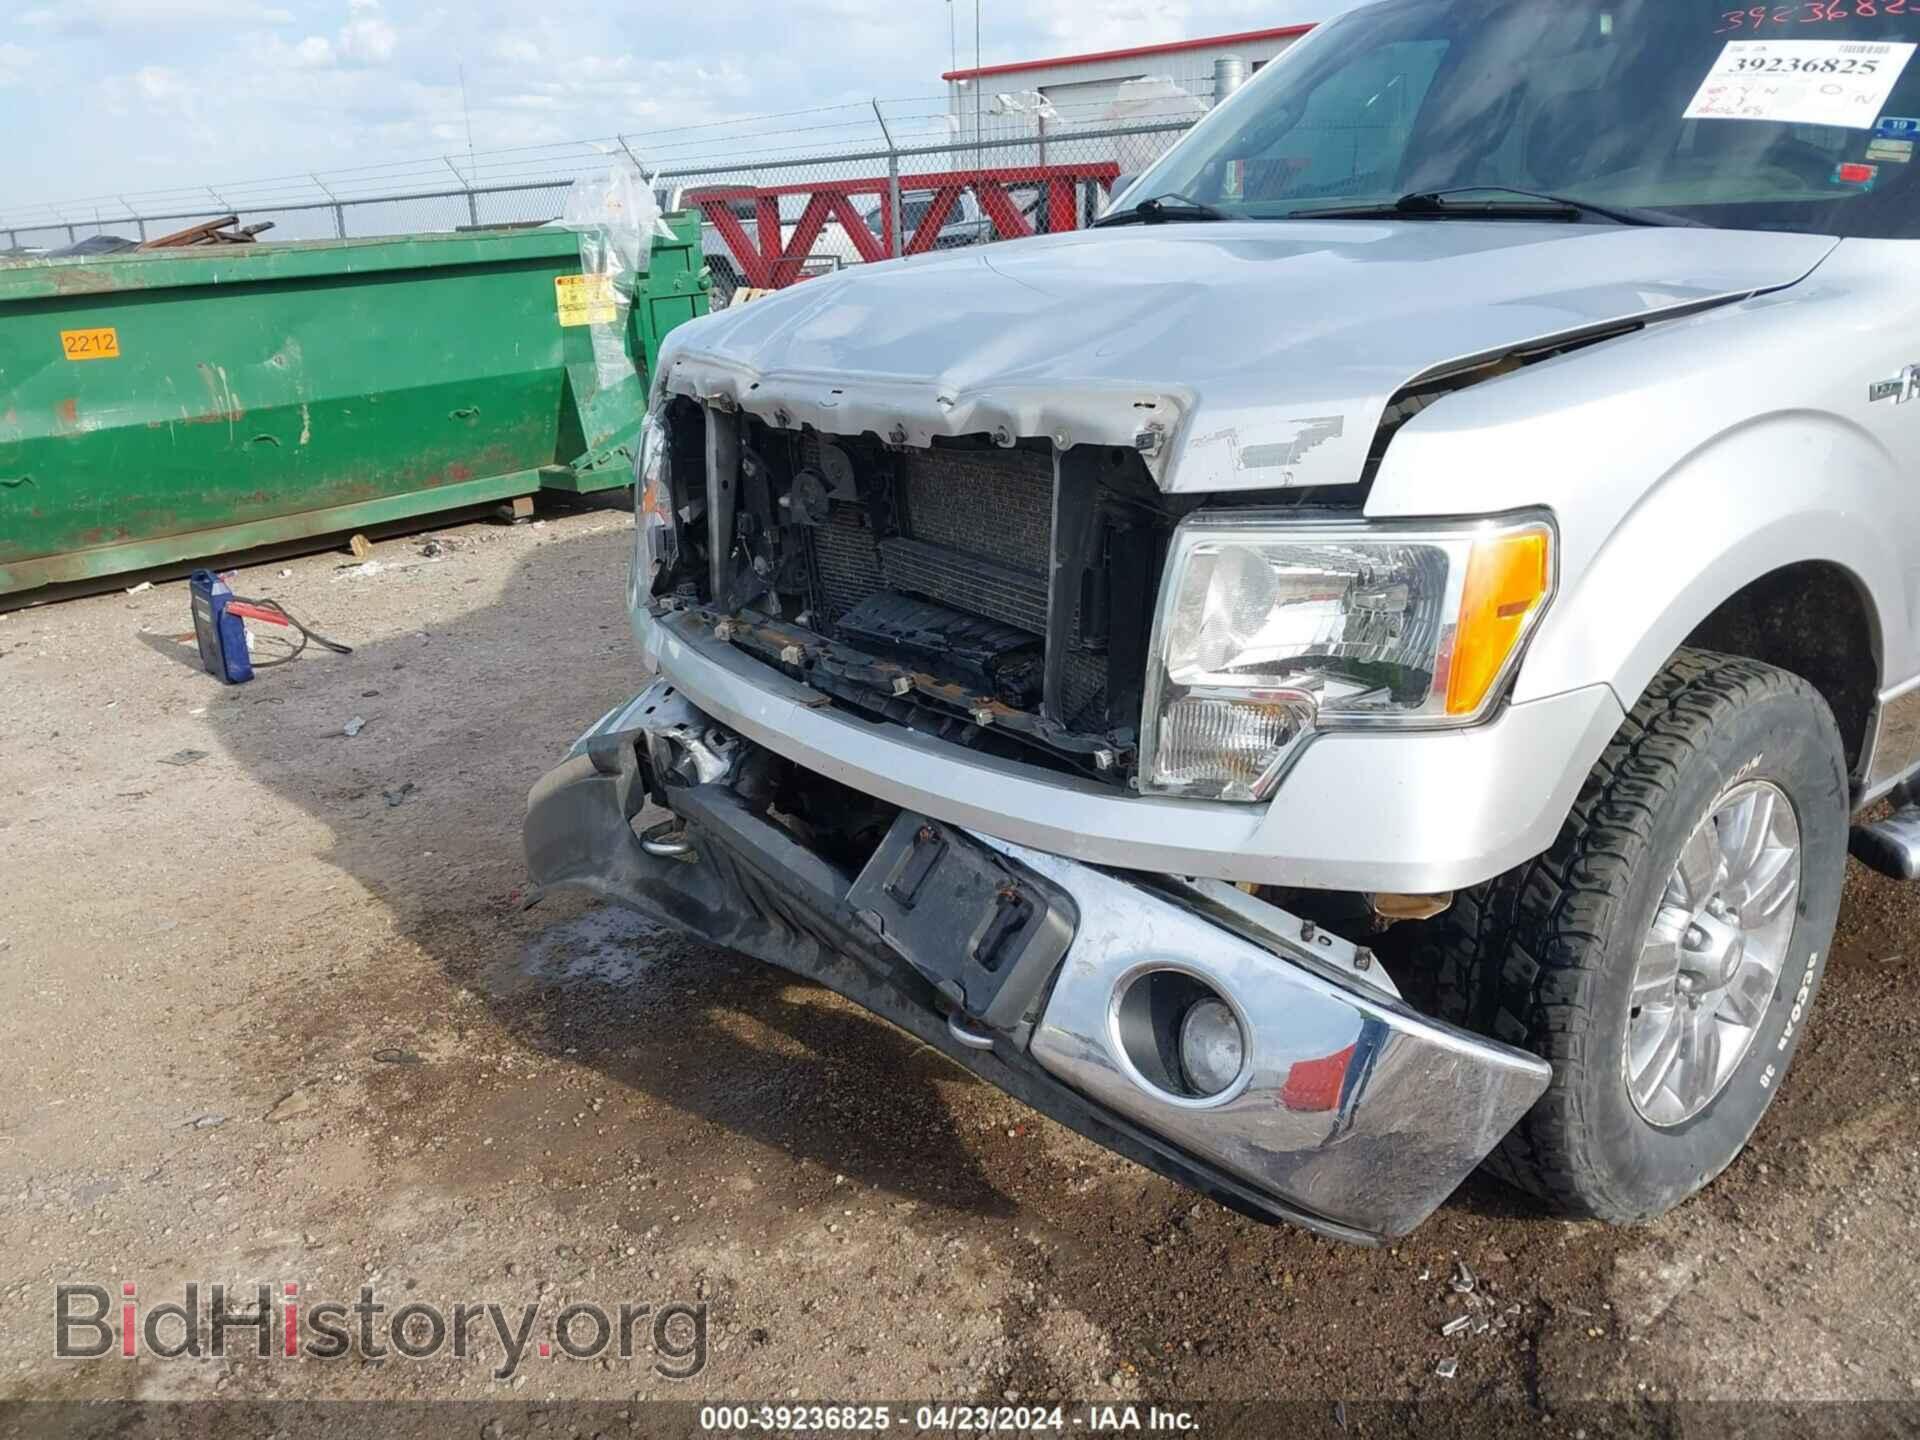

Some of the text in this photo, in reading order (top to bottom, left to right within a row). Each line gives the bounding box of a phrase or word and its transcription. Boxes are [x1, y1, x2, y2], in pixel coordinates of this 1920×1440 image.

[1719, 0, 1920, 31] 3923682
[1728, 57, 1880, 75] 39236825
[65, 333, 116, 353] 2212
